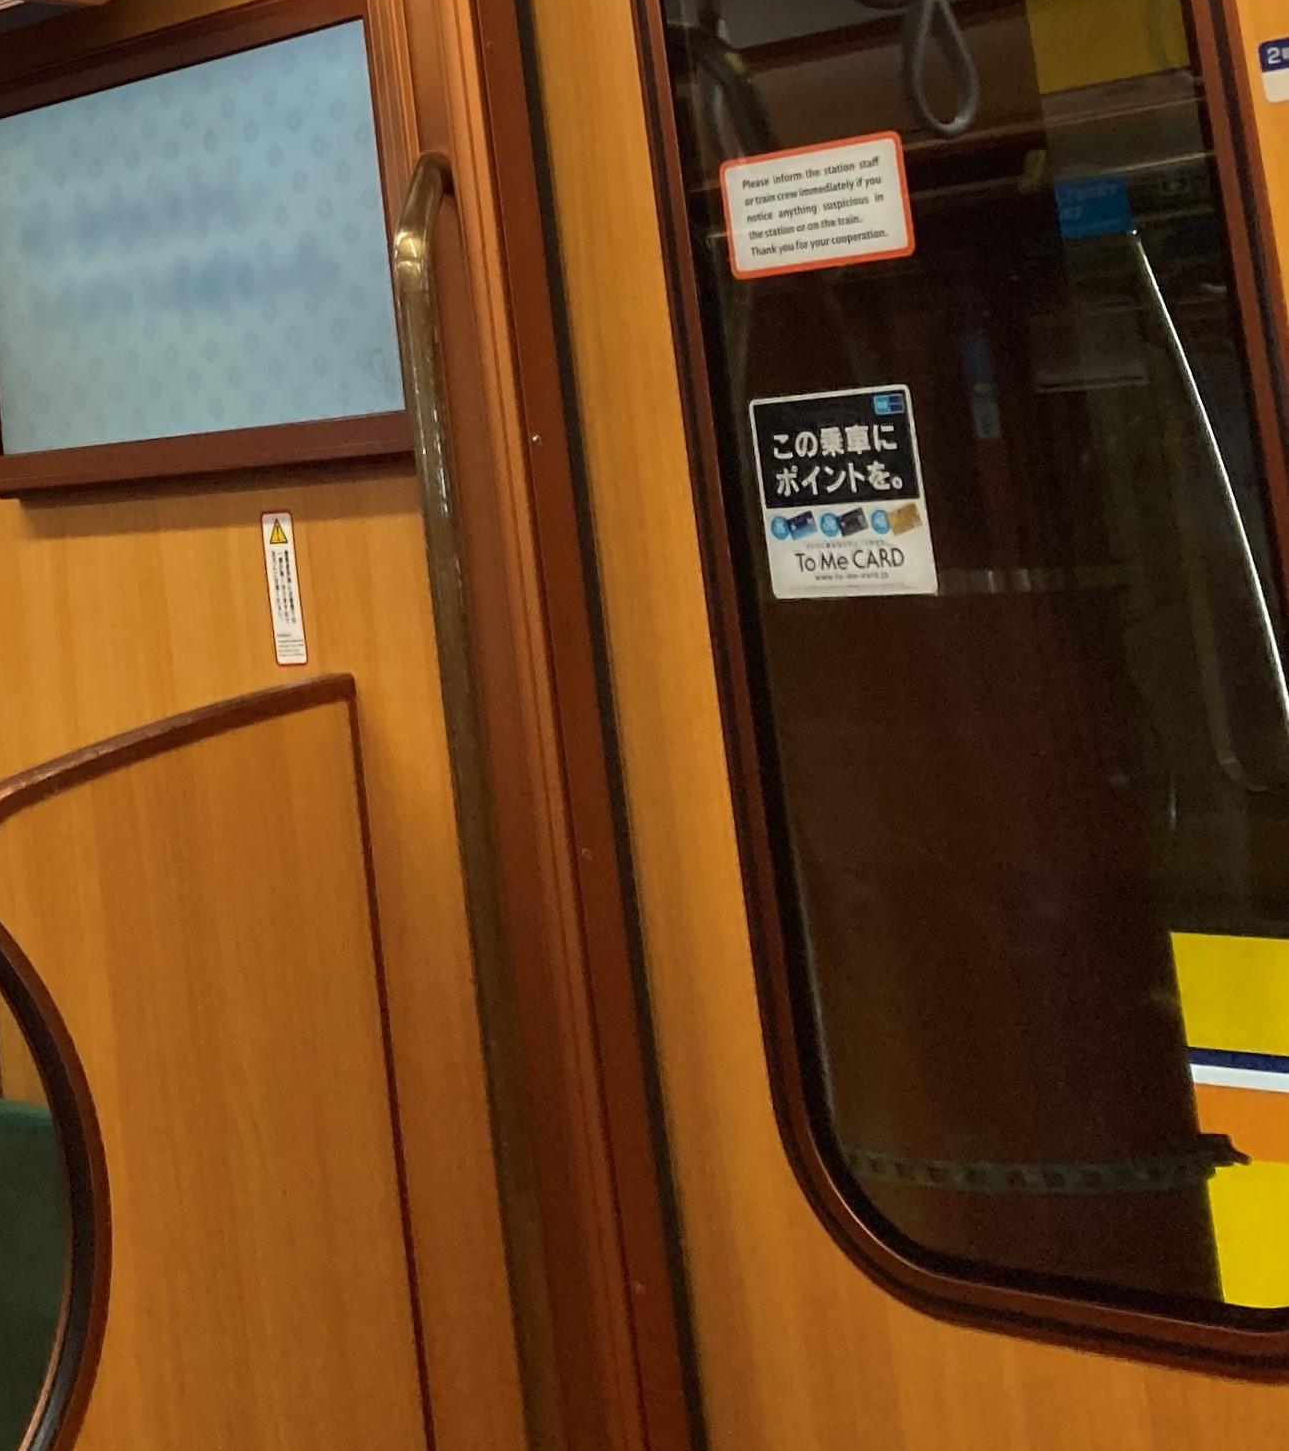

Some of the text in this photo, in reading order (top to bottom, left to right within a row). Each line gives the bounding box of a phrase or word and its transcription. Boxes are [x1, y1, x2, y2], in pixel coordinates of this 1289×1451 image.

[742, 156, 879, 189] Please inform the station staff
[744, 176, 882, 207] or train crew immediately if you
[746, 193, 884, 223] notice anything suspicious in
[749, 214, 862, 240] the station or on the train.
[751, 229, 889, 257] Thank you for your cooperation.
[773, 424, 898, 460] この乗車に
[775, 461, 903, 497] ポイントを。
[795, 548, 905, 573] To Me CARD
